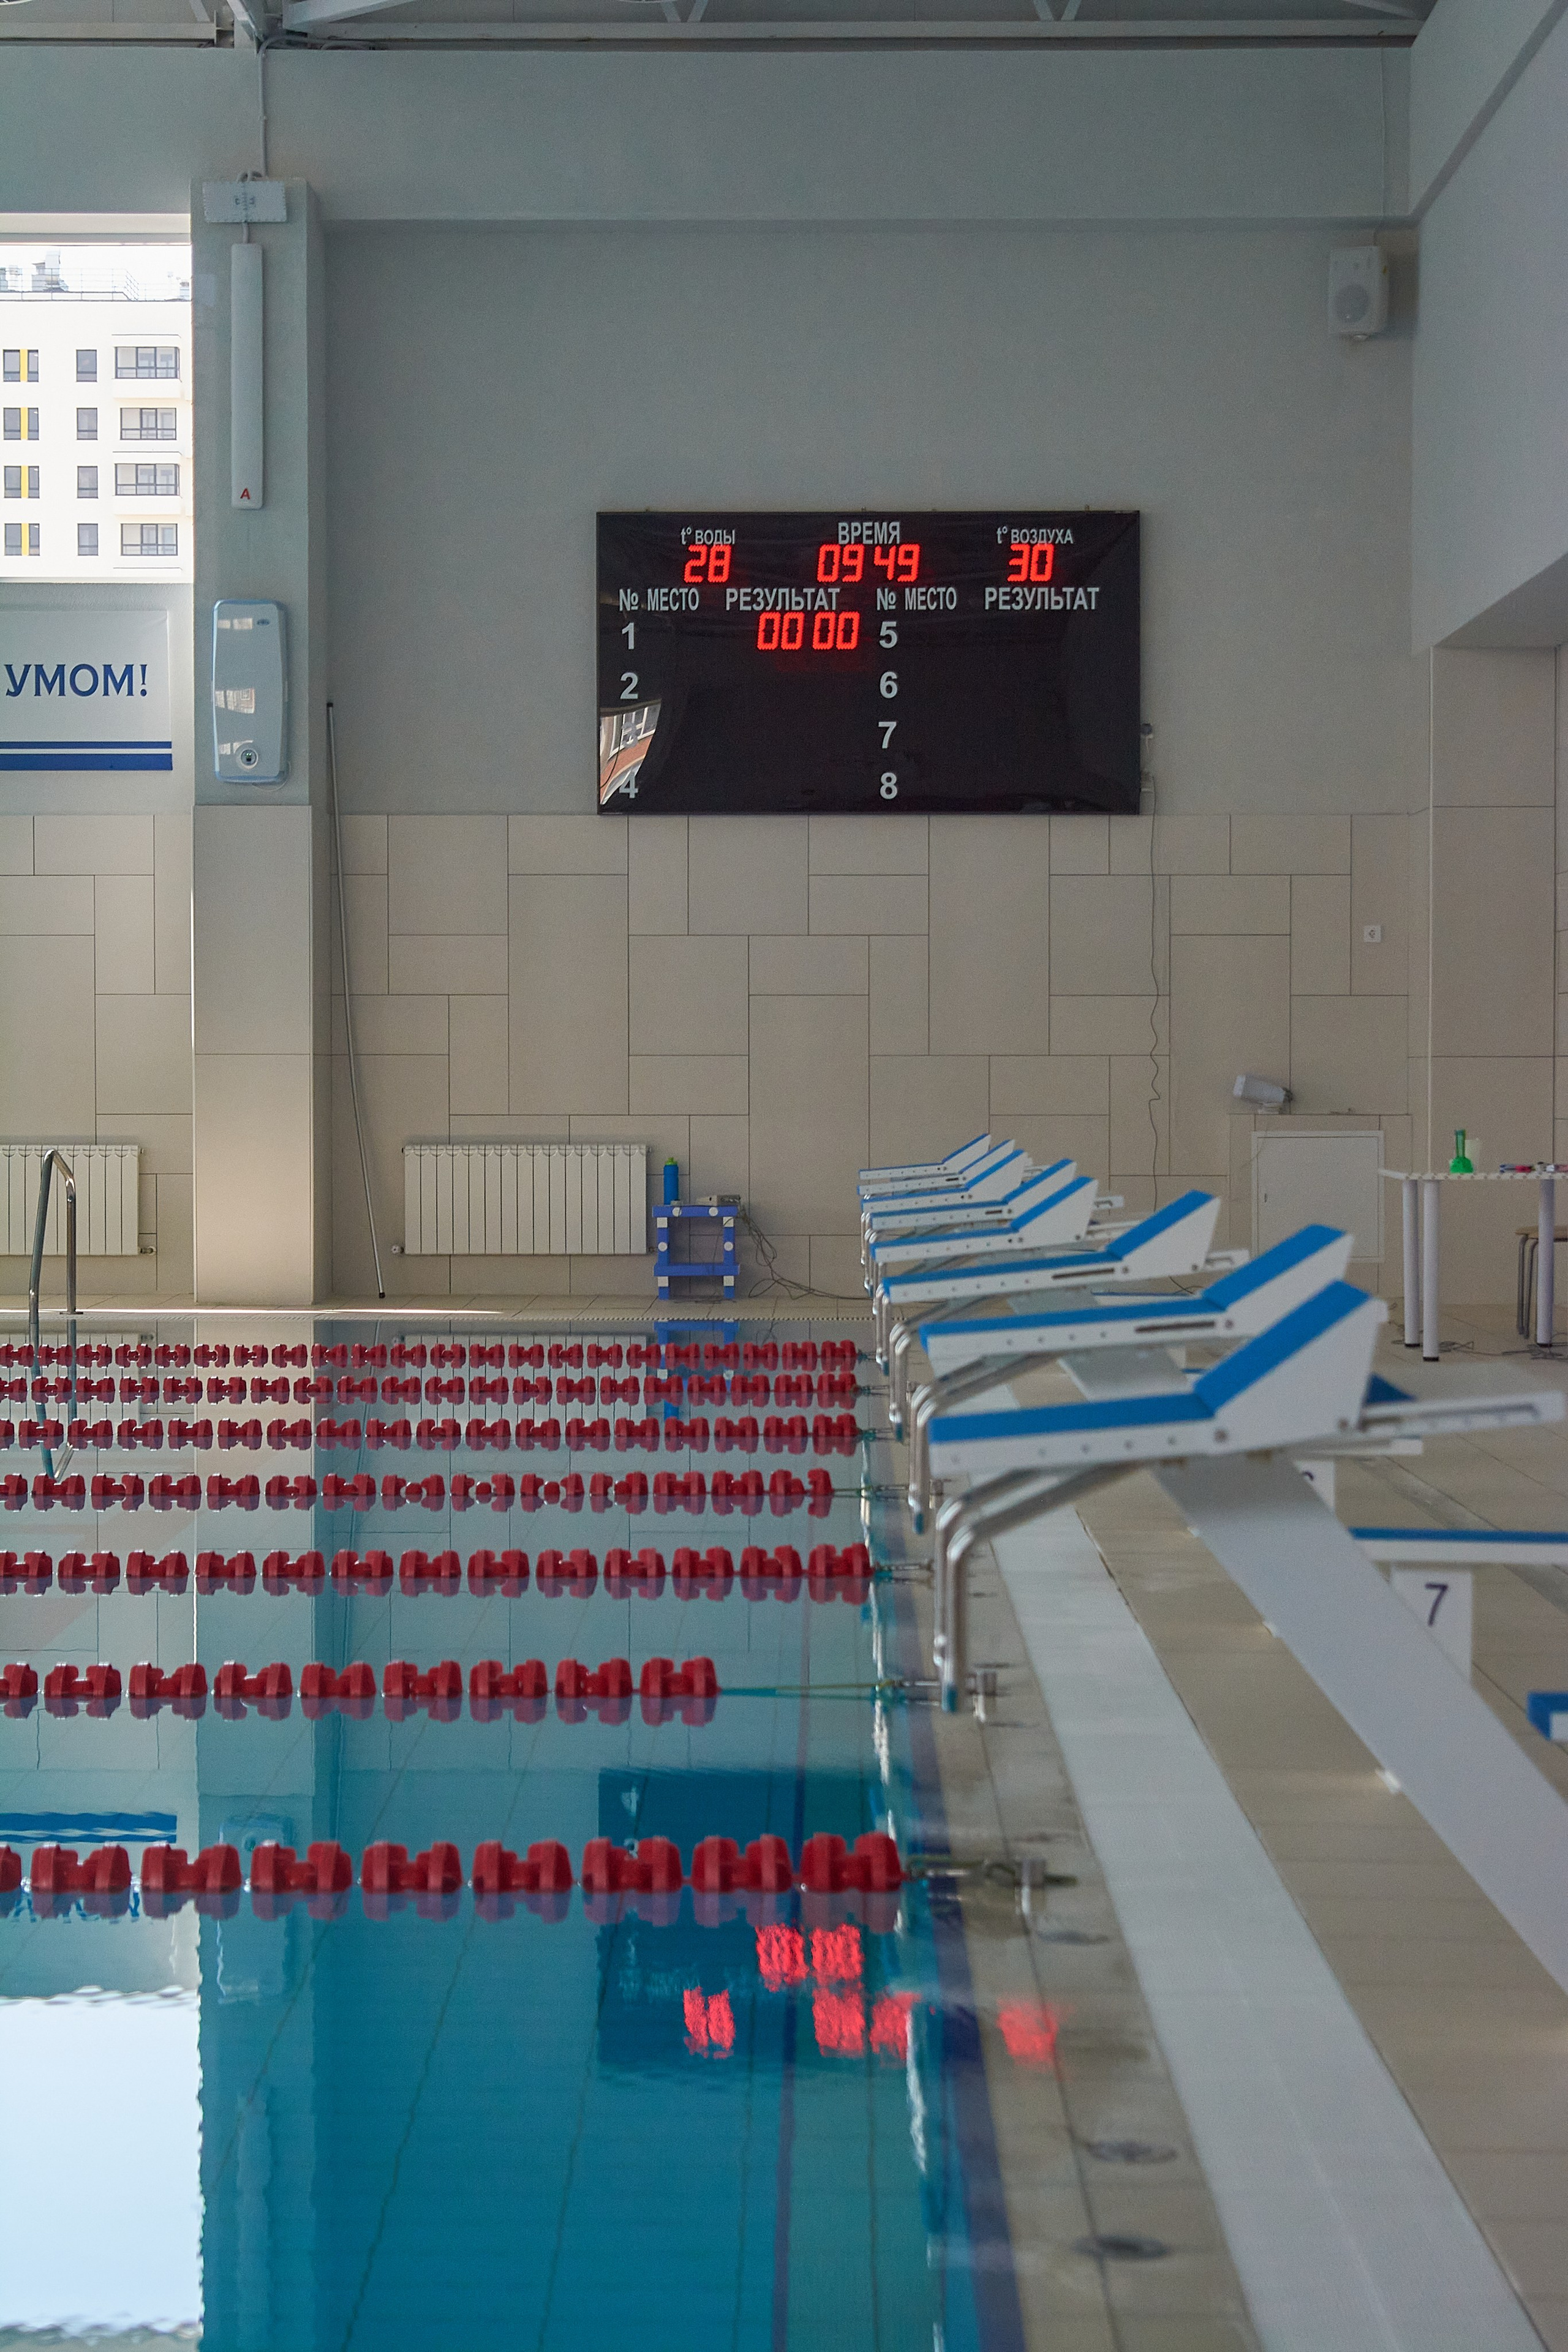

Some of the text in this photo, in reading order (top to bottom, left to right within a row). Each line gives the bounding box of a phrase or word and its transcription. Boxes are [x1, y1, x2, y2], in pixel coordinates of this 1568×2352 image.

[695, 529, 736, 546] ВОДЫ
[838, 521, 901, 545] ВРЕМЯ
[1011, 529, 1074, 545] ВОЗДУХА
[684, 544, 732, 583] 28
[1006, 543, 1055, 582] 30
[647, 588, 699, 611] МЕСТО
[726, 588, 840, 611] РЕЗУЛЬТАТ
[905, 587, 957, 610] МЕСТО
[985, 587, 1099, 610] РЕЗУЛЬТАТ
[622, 622, 635, 650] 1
[879, 621, 898, 649] 5
[4, 663, 148, 697] УМОМ!
[620, 672, 639, 699] 2
[880, 671, 898, 699] 6
[621, 722, 638, 748] 3
[878, 721, 897, 748] 7
[619, 771, 639, 799] 4
[880, 772, 898, 800] 8
[1424, 1582, 1449, 1627] 7
